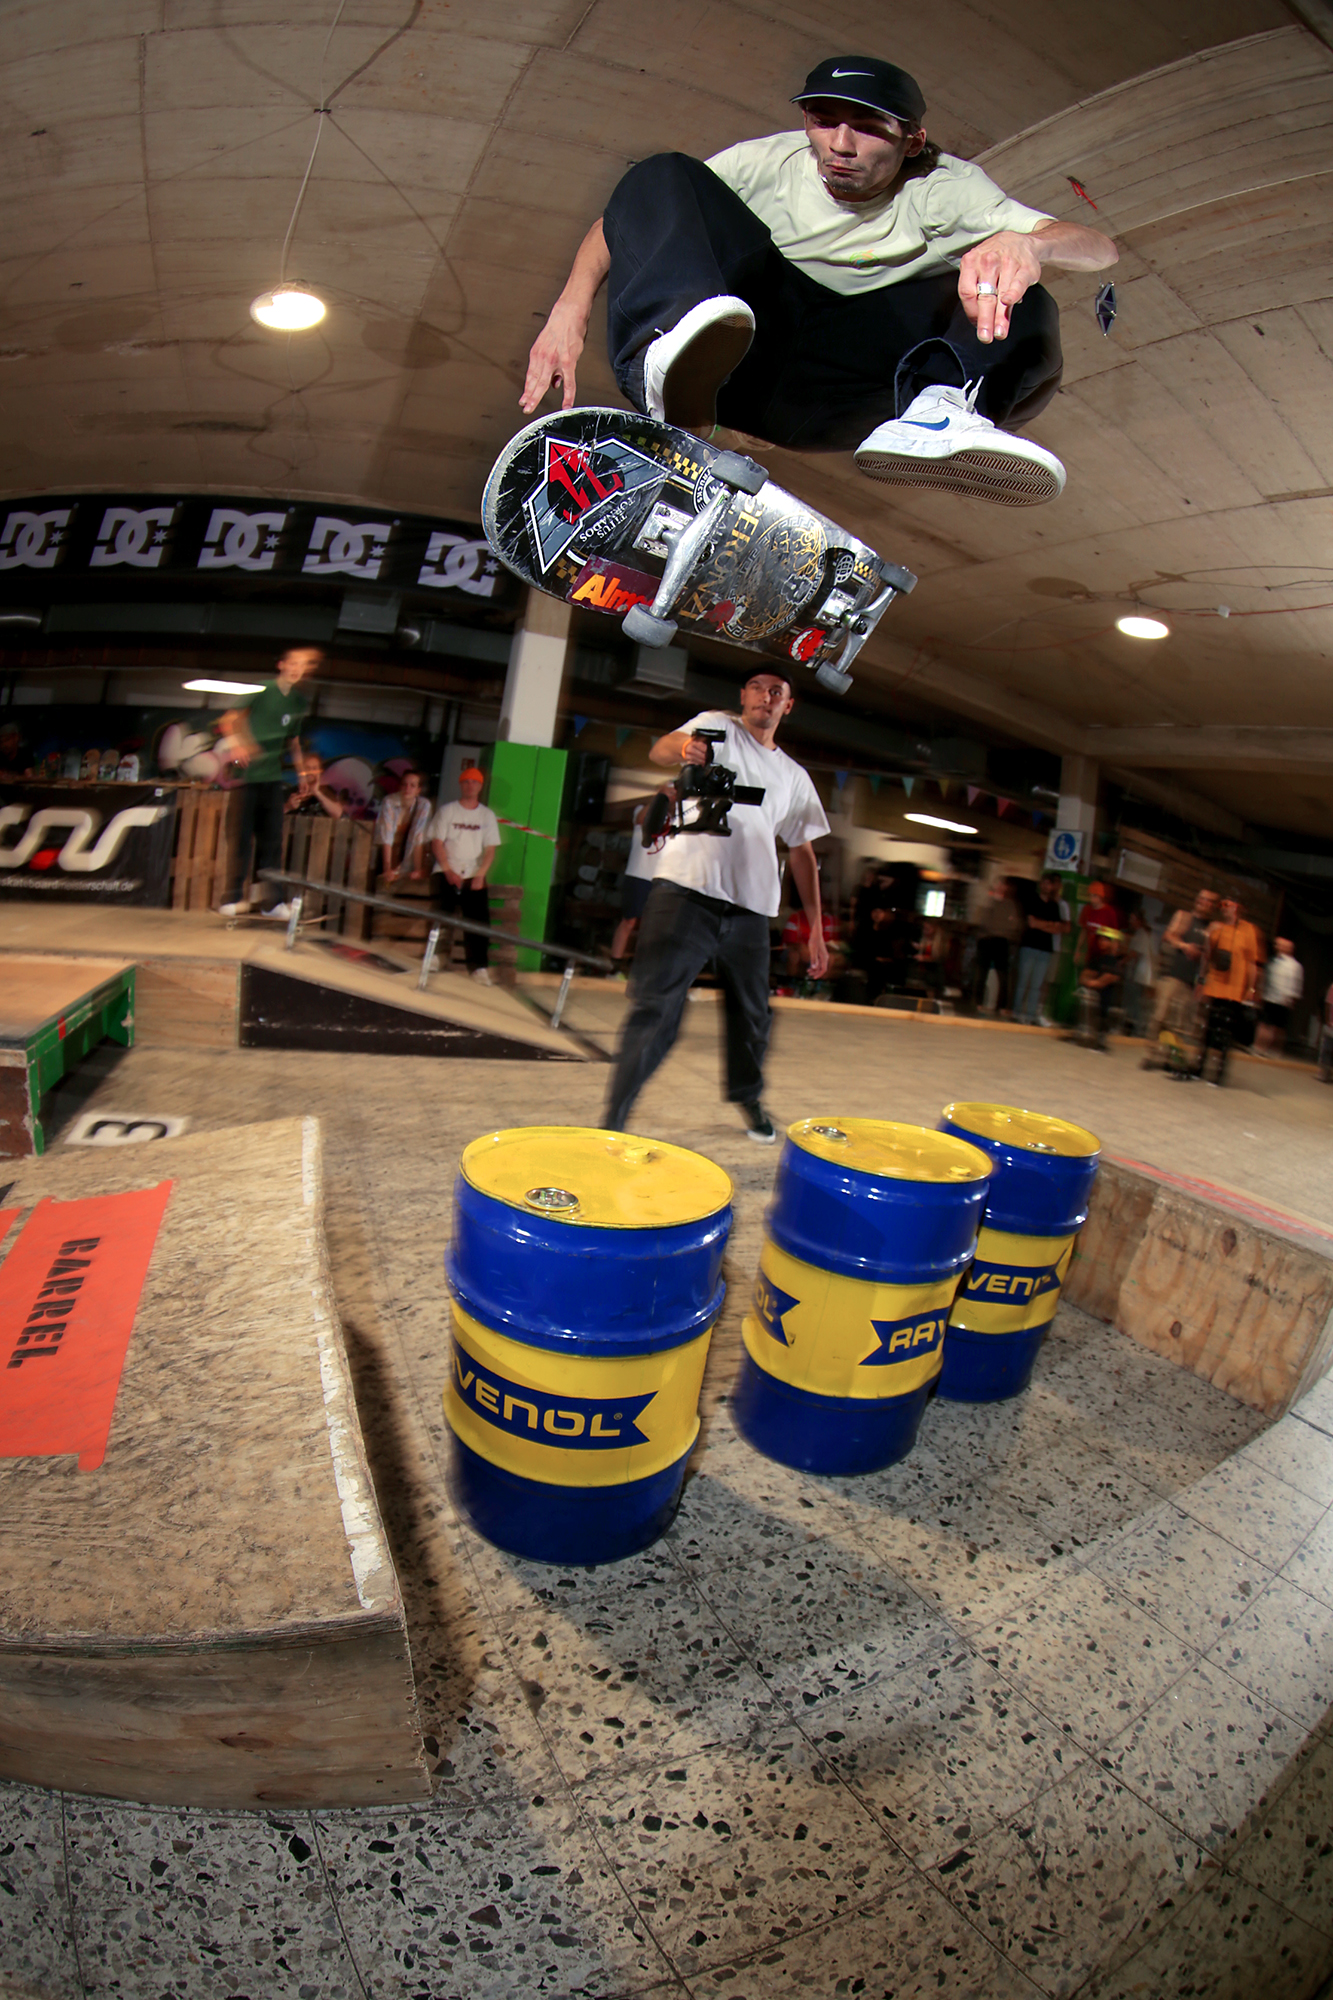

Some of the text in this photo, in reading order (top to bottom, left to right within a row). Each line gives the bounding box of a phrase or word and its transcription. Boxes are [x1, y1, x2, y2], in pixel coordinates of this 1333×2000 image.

[89, 507, 175, 567] DC
[197, 508, 287, 571] DC
[301, 516, 392, 579] DC
[579, 496, 636, 542] TORNADOS
[596, 513, 628, 539] TITUS
[572, 573, 655, 612] Alm
[6, 1237, 101, 1369] BARREL
[453, 1356, 622, 1438] VENOL
